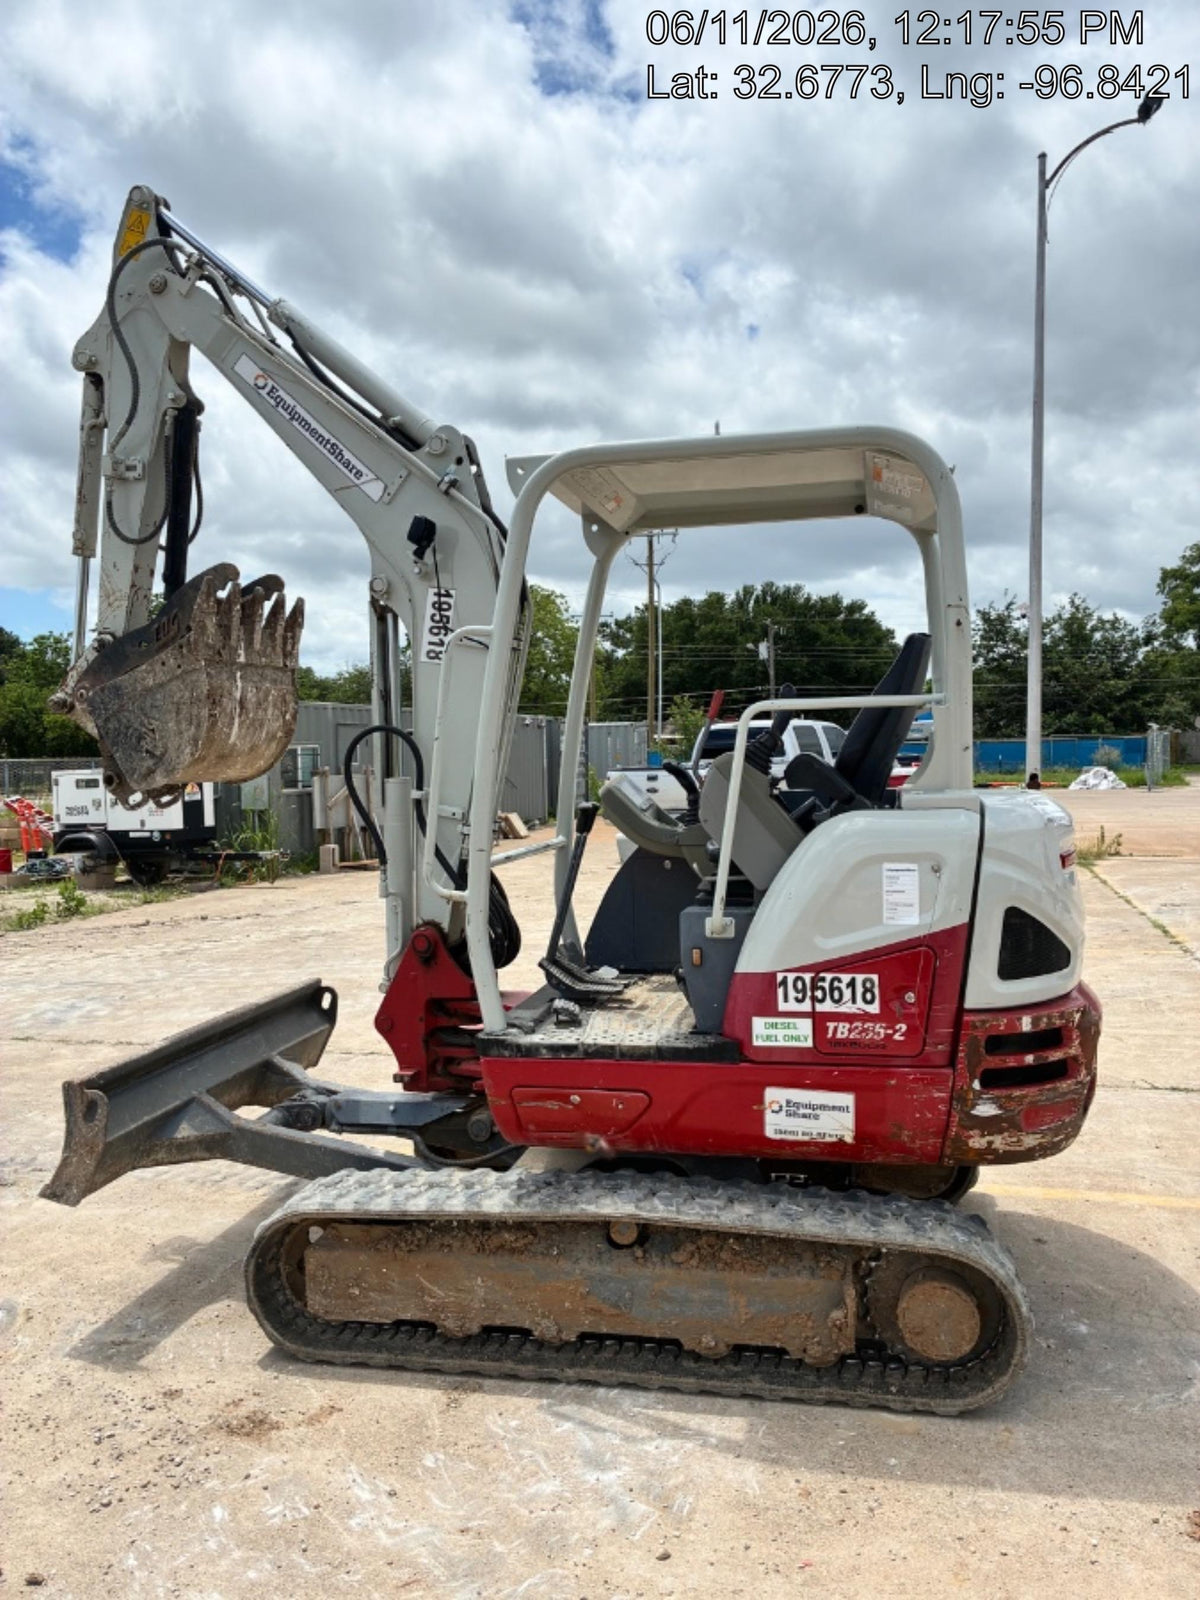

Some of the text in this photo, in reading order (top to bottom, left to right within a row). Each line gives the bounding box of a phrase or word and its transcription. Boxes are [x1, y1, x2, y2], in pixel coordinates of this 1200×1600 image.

[266, 385, 364, 481] EquipmentShare
[777, 975, 877, 1005] 195618
[764, 1021, 799, 1031] DIESEL
[755, 1033, 810, 1044] FUEL ONLY
[785, 1098, 851, 1114] Equipment
[785, 1109, 820, 1121] Share
